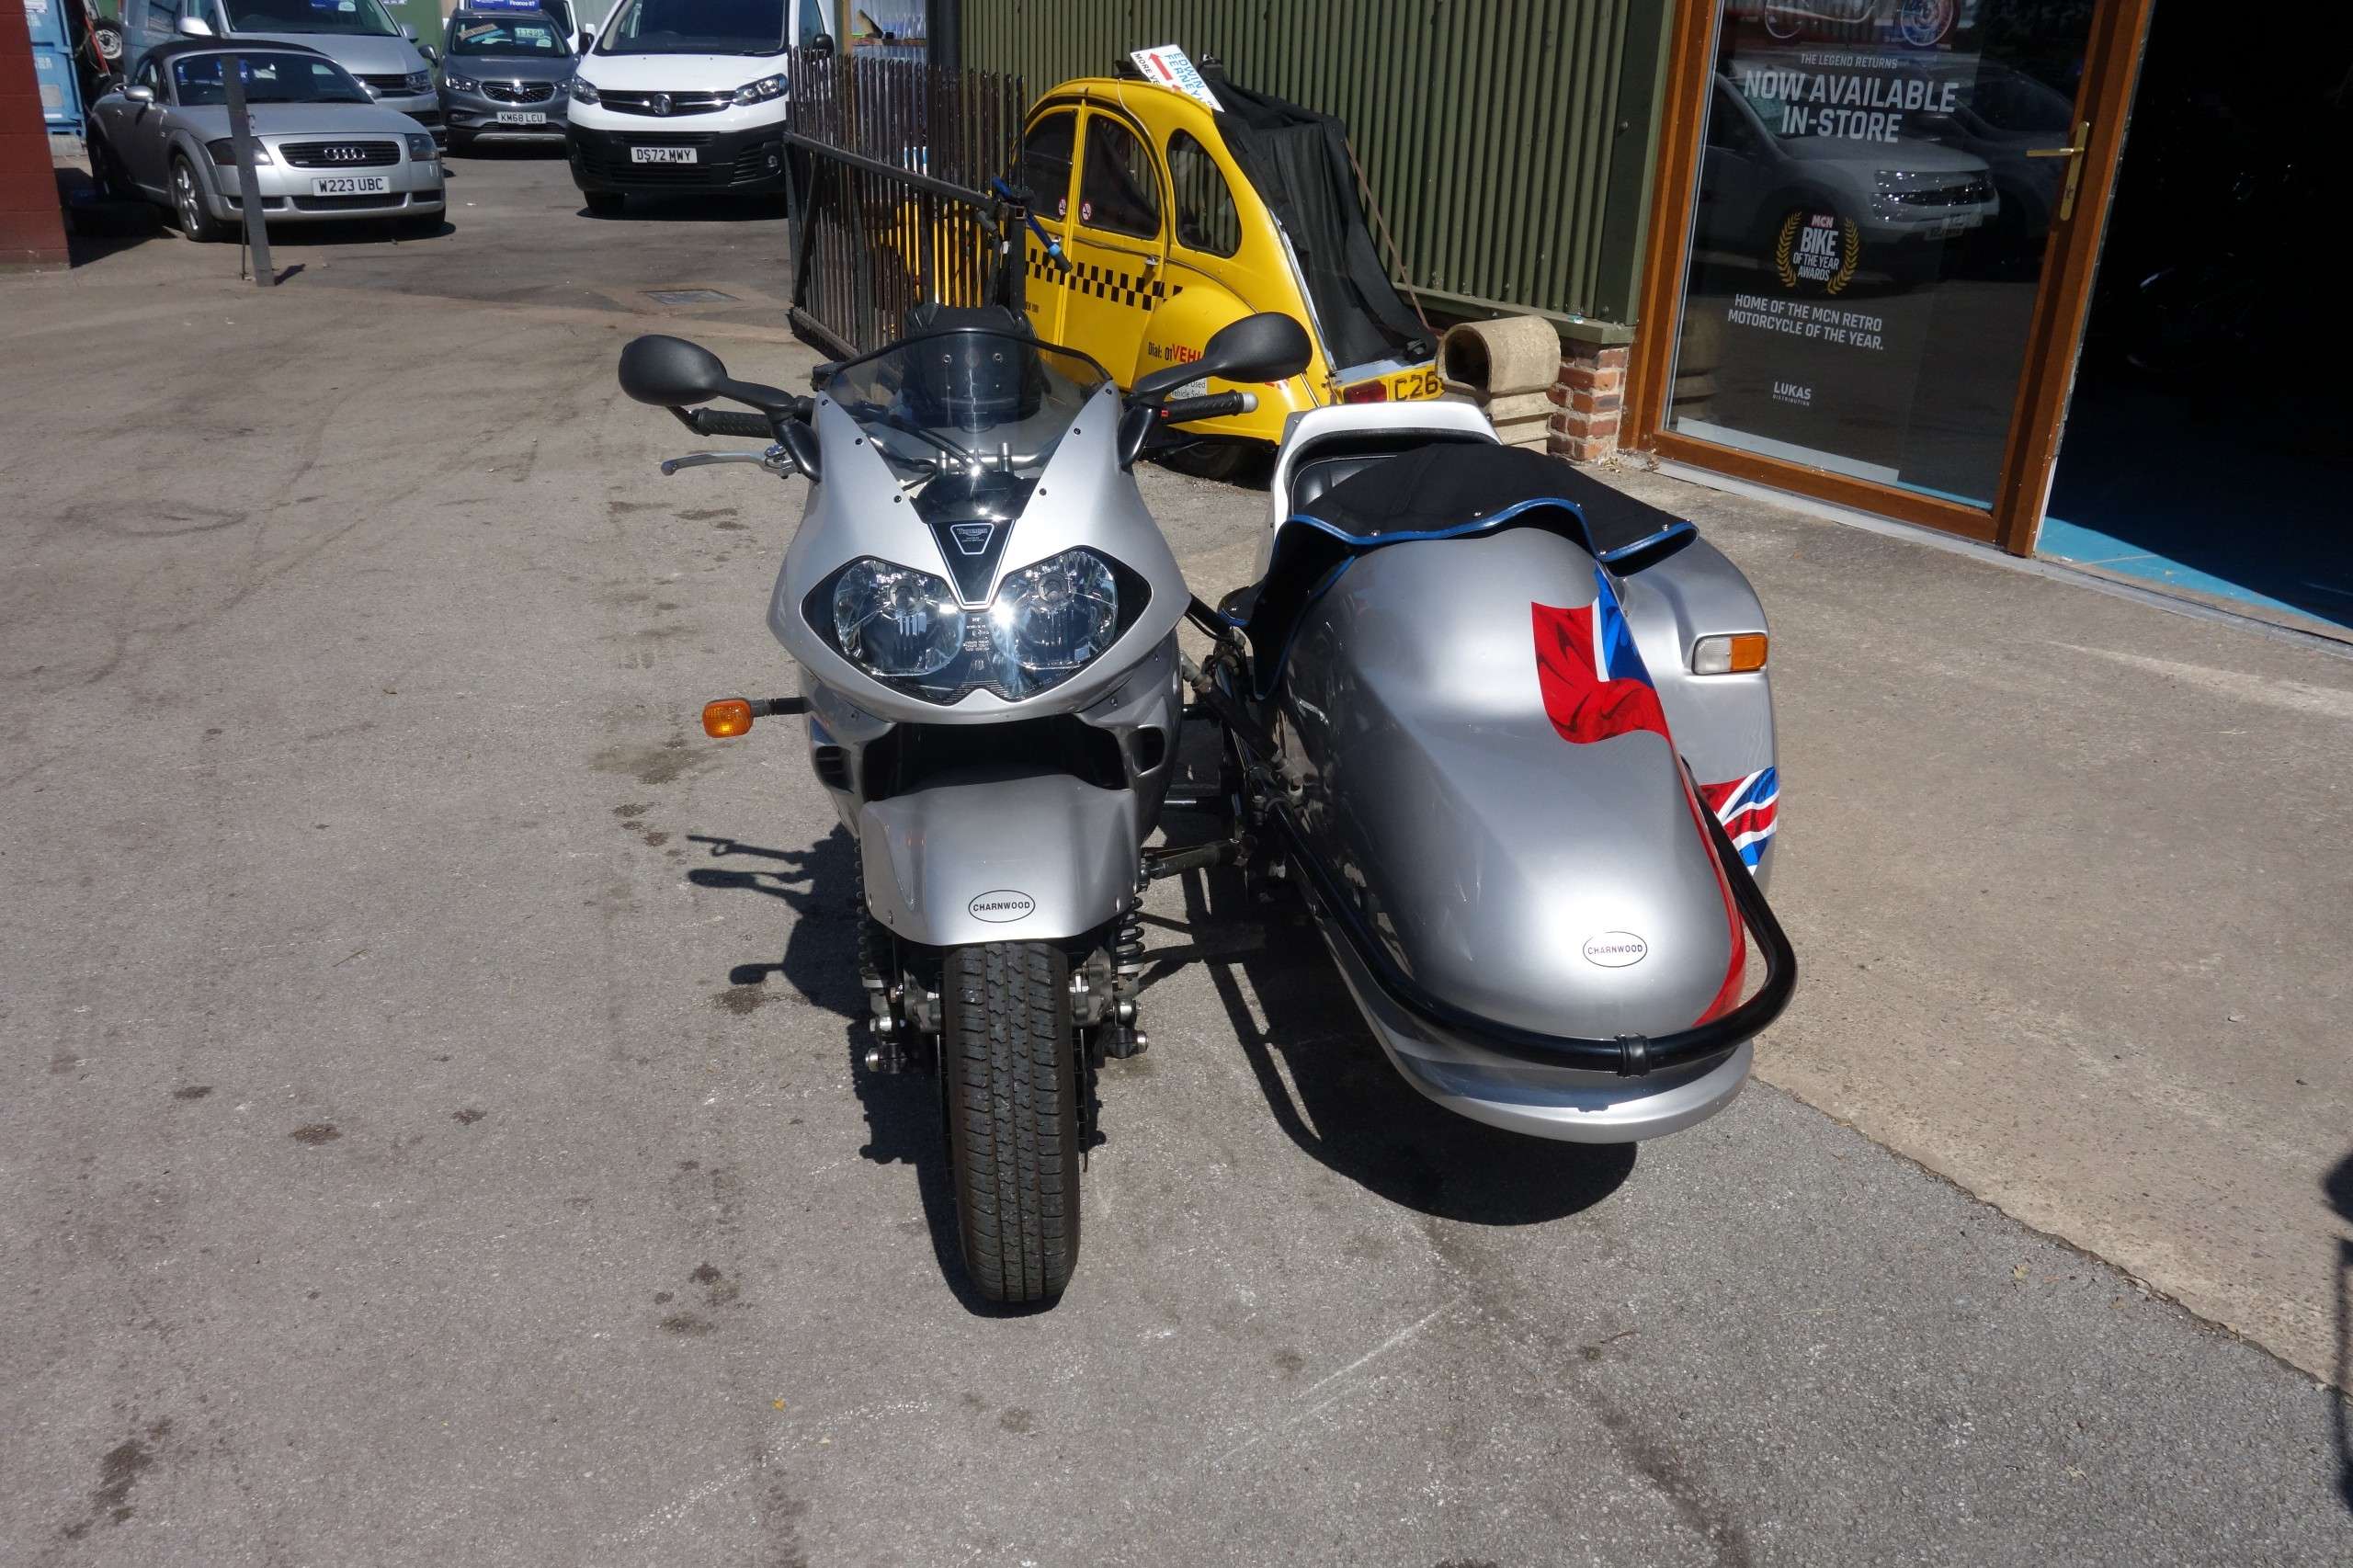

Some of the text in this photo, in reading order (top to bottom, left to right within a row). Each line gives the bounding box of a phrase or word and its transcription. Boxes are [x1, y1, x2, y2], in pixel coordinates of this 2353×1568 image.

[1133, 52, 1153, 74] MORE
[1802, 53, 1898, 69] THE LEGEND RETURNS
[1174, 52, 1205, 89] EDWIN
[1744, 70, 1960, 113] NOW AVAILABLE
[501, 114, 524, 122] KM68
[1781, 105, 1903, 143] IN-STORE
[636, 149, 691, 161] DS72 MWY
[319, 178, 383, 192] W223 UBC
[1811, 214, 1834, 228] MCN
[1800, 226, 1839, 256] BIKE
[1792, 252, 1840, 270] OF THE YEAR
[1797, 265, 1831, 281] AWARDS
[1734, 293, 1883, 332] HOME OF THE MCN RETRO
[1727, 309, 1883, 350] MOTORCYCLE OF THE YEAR.
[1774, 381, 1812, 400] LUKAS
[972, 902, 1030, 912] CHARNWOOD
[1587, 944, 1643, 955] CHARNWOOD
